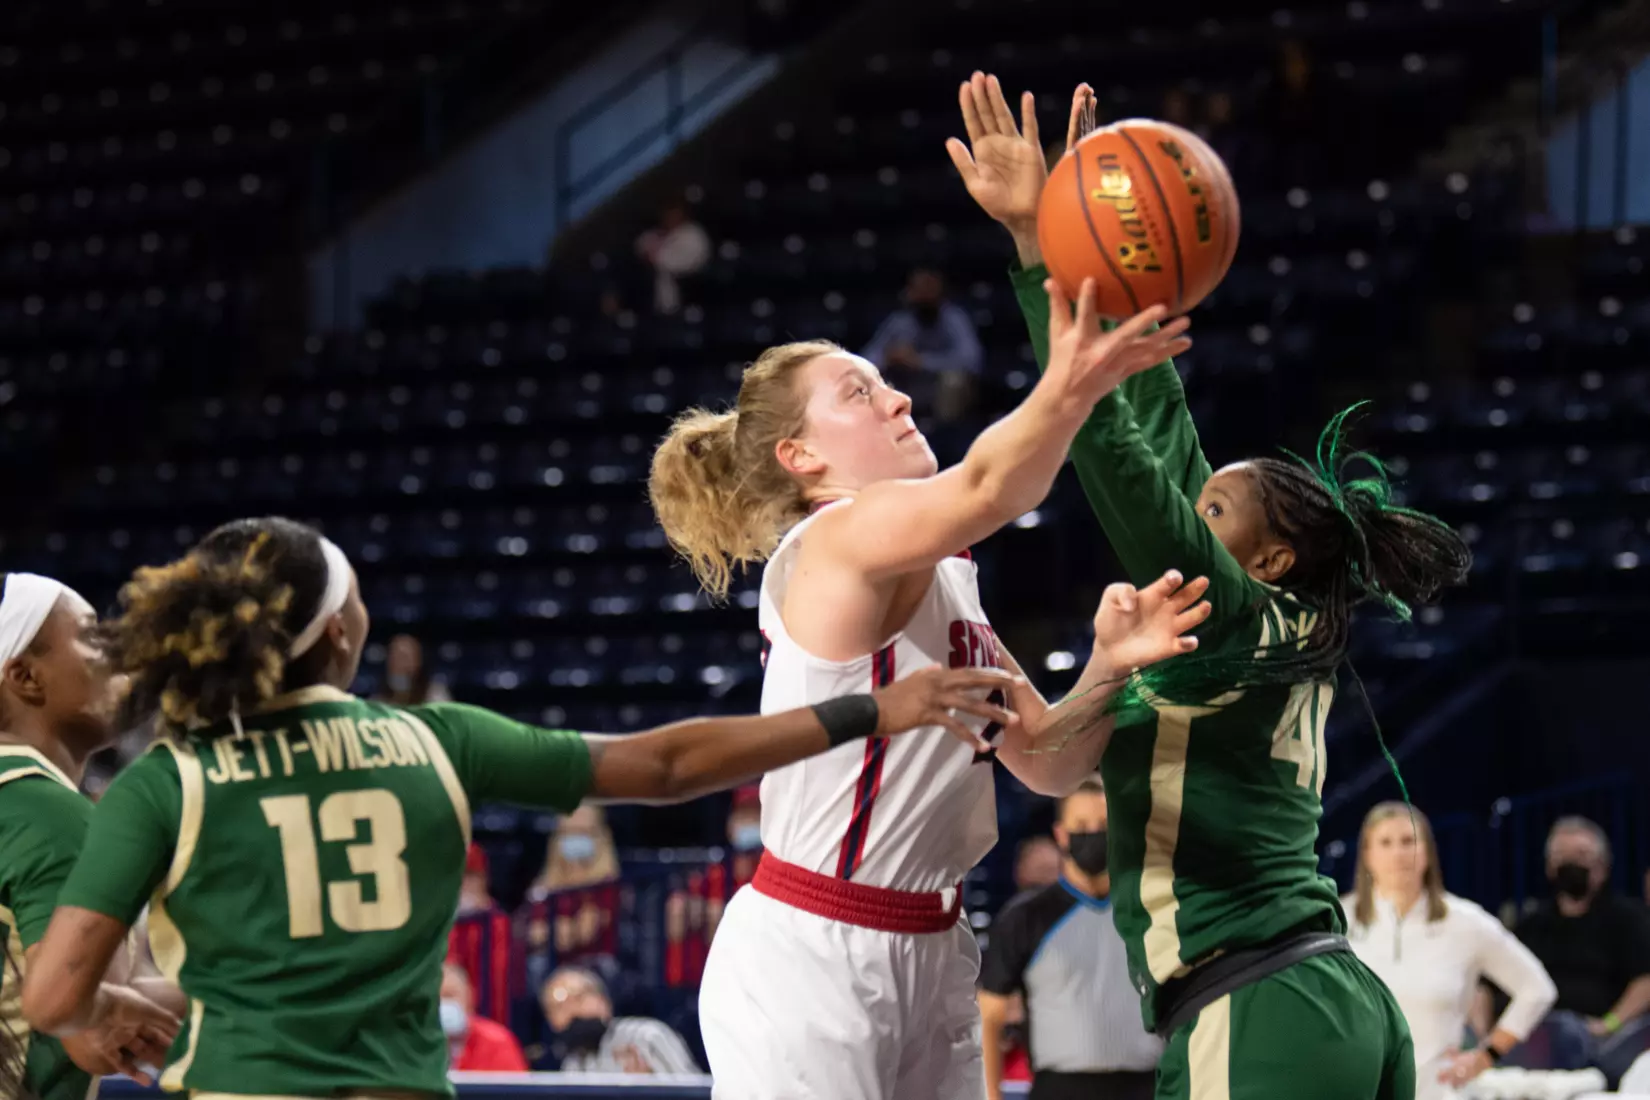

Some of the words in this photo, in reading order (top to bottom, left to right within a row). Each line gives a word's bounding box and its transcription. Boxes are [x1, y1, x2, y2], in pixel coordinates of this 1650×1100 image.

[1091, 152, 1162, 272] Baden
[206, 717, 429, 784] JETT-WILSON
[259, 788, 412, 939] 13
